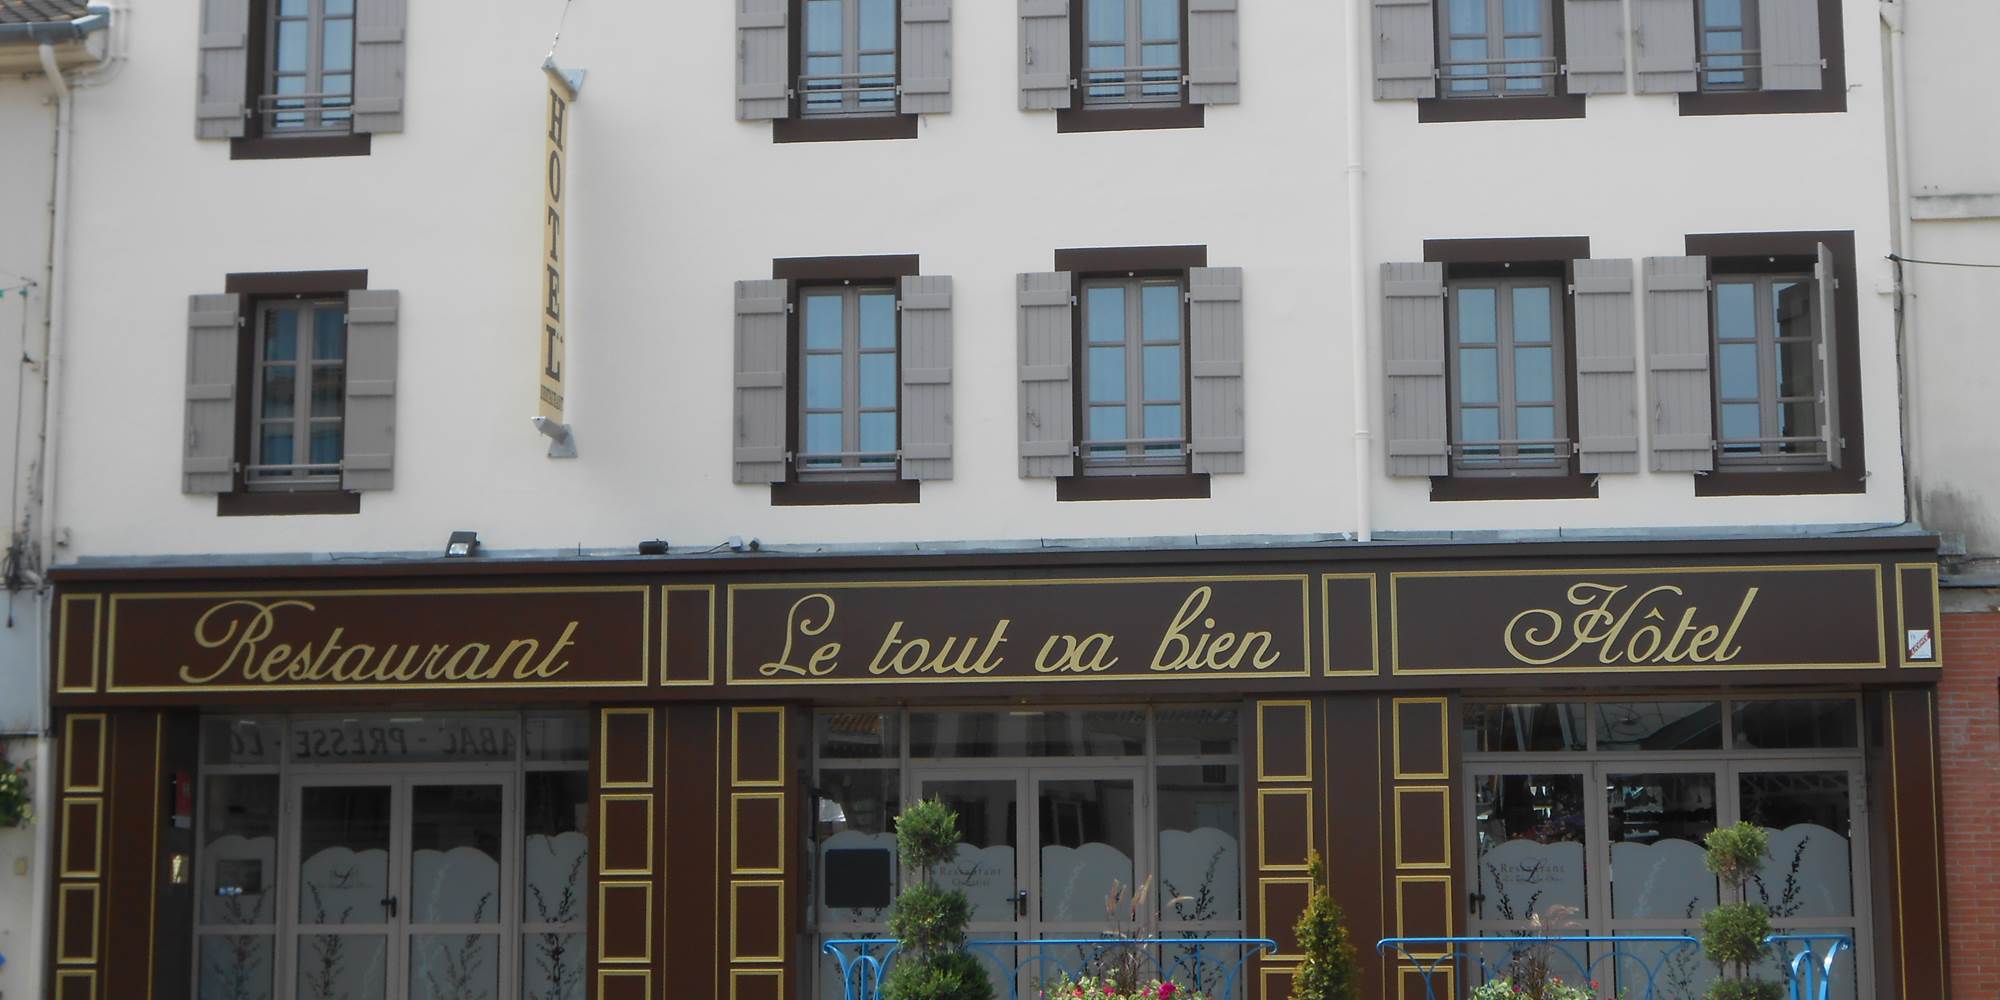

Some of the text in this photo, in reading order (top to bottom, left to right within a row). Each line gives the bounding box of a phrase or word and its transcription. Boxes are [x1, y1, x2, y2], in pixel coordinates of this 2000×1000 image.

[544, 87, 566, 383] HOTEL
[179, 599, 579, 684] Restaurant
[758, 585, 1281, 677] Le tout va bien
[1503, 582, 1760, 666] Hôtel
